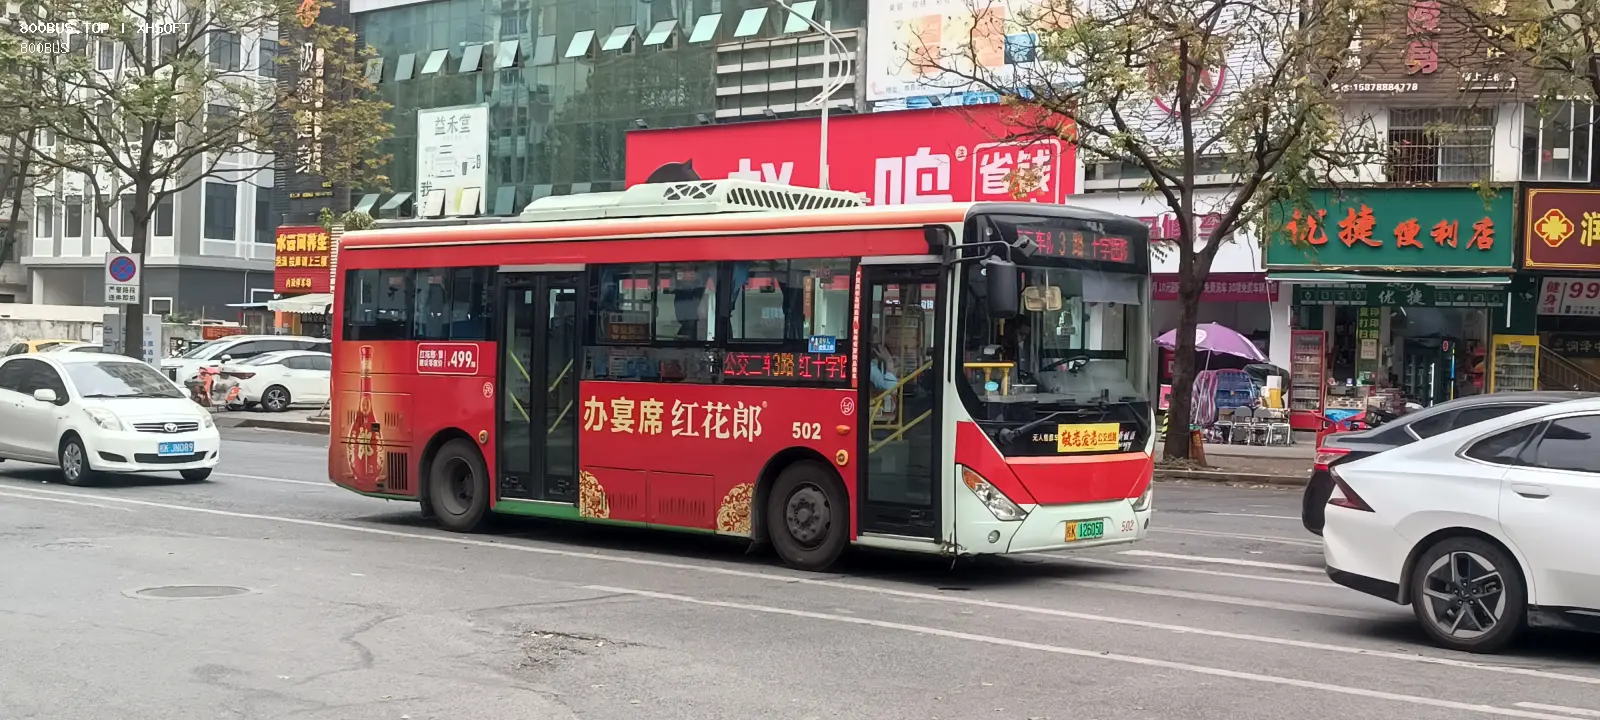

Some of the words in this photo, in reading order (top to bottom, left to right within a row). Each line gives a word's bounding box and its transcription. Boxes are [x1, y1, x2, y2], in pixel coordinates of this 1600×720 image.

[434, 113, 472, 136] 益禾堂
[1286, 203, 1496, 251] 优捷便利店
[1378, 288, 1426, 305] 优捷
[1359, 318, 1380, 328] 打印
[583, 395, 664, 435] 办宴席
[671, 399, 763, 443] 红花郎
[791, 421, 822, 440] 502
[1121, 520, 1135, 532] 502
